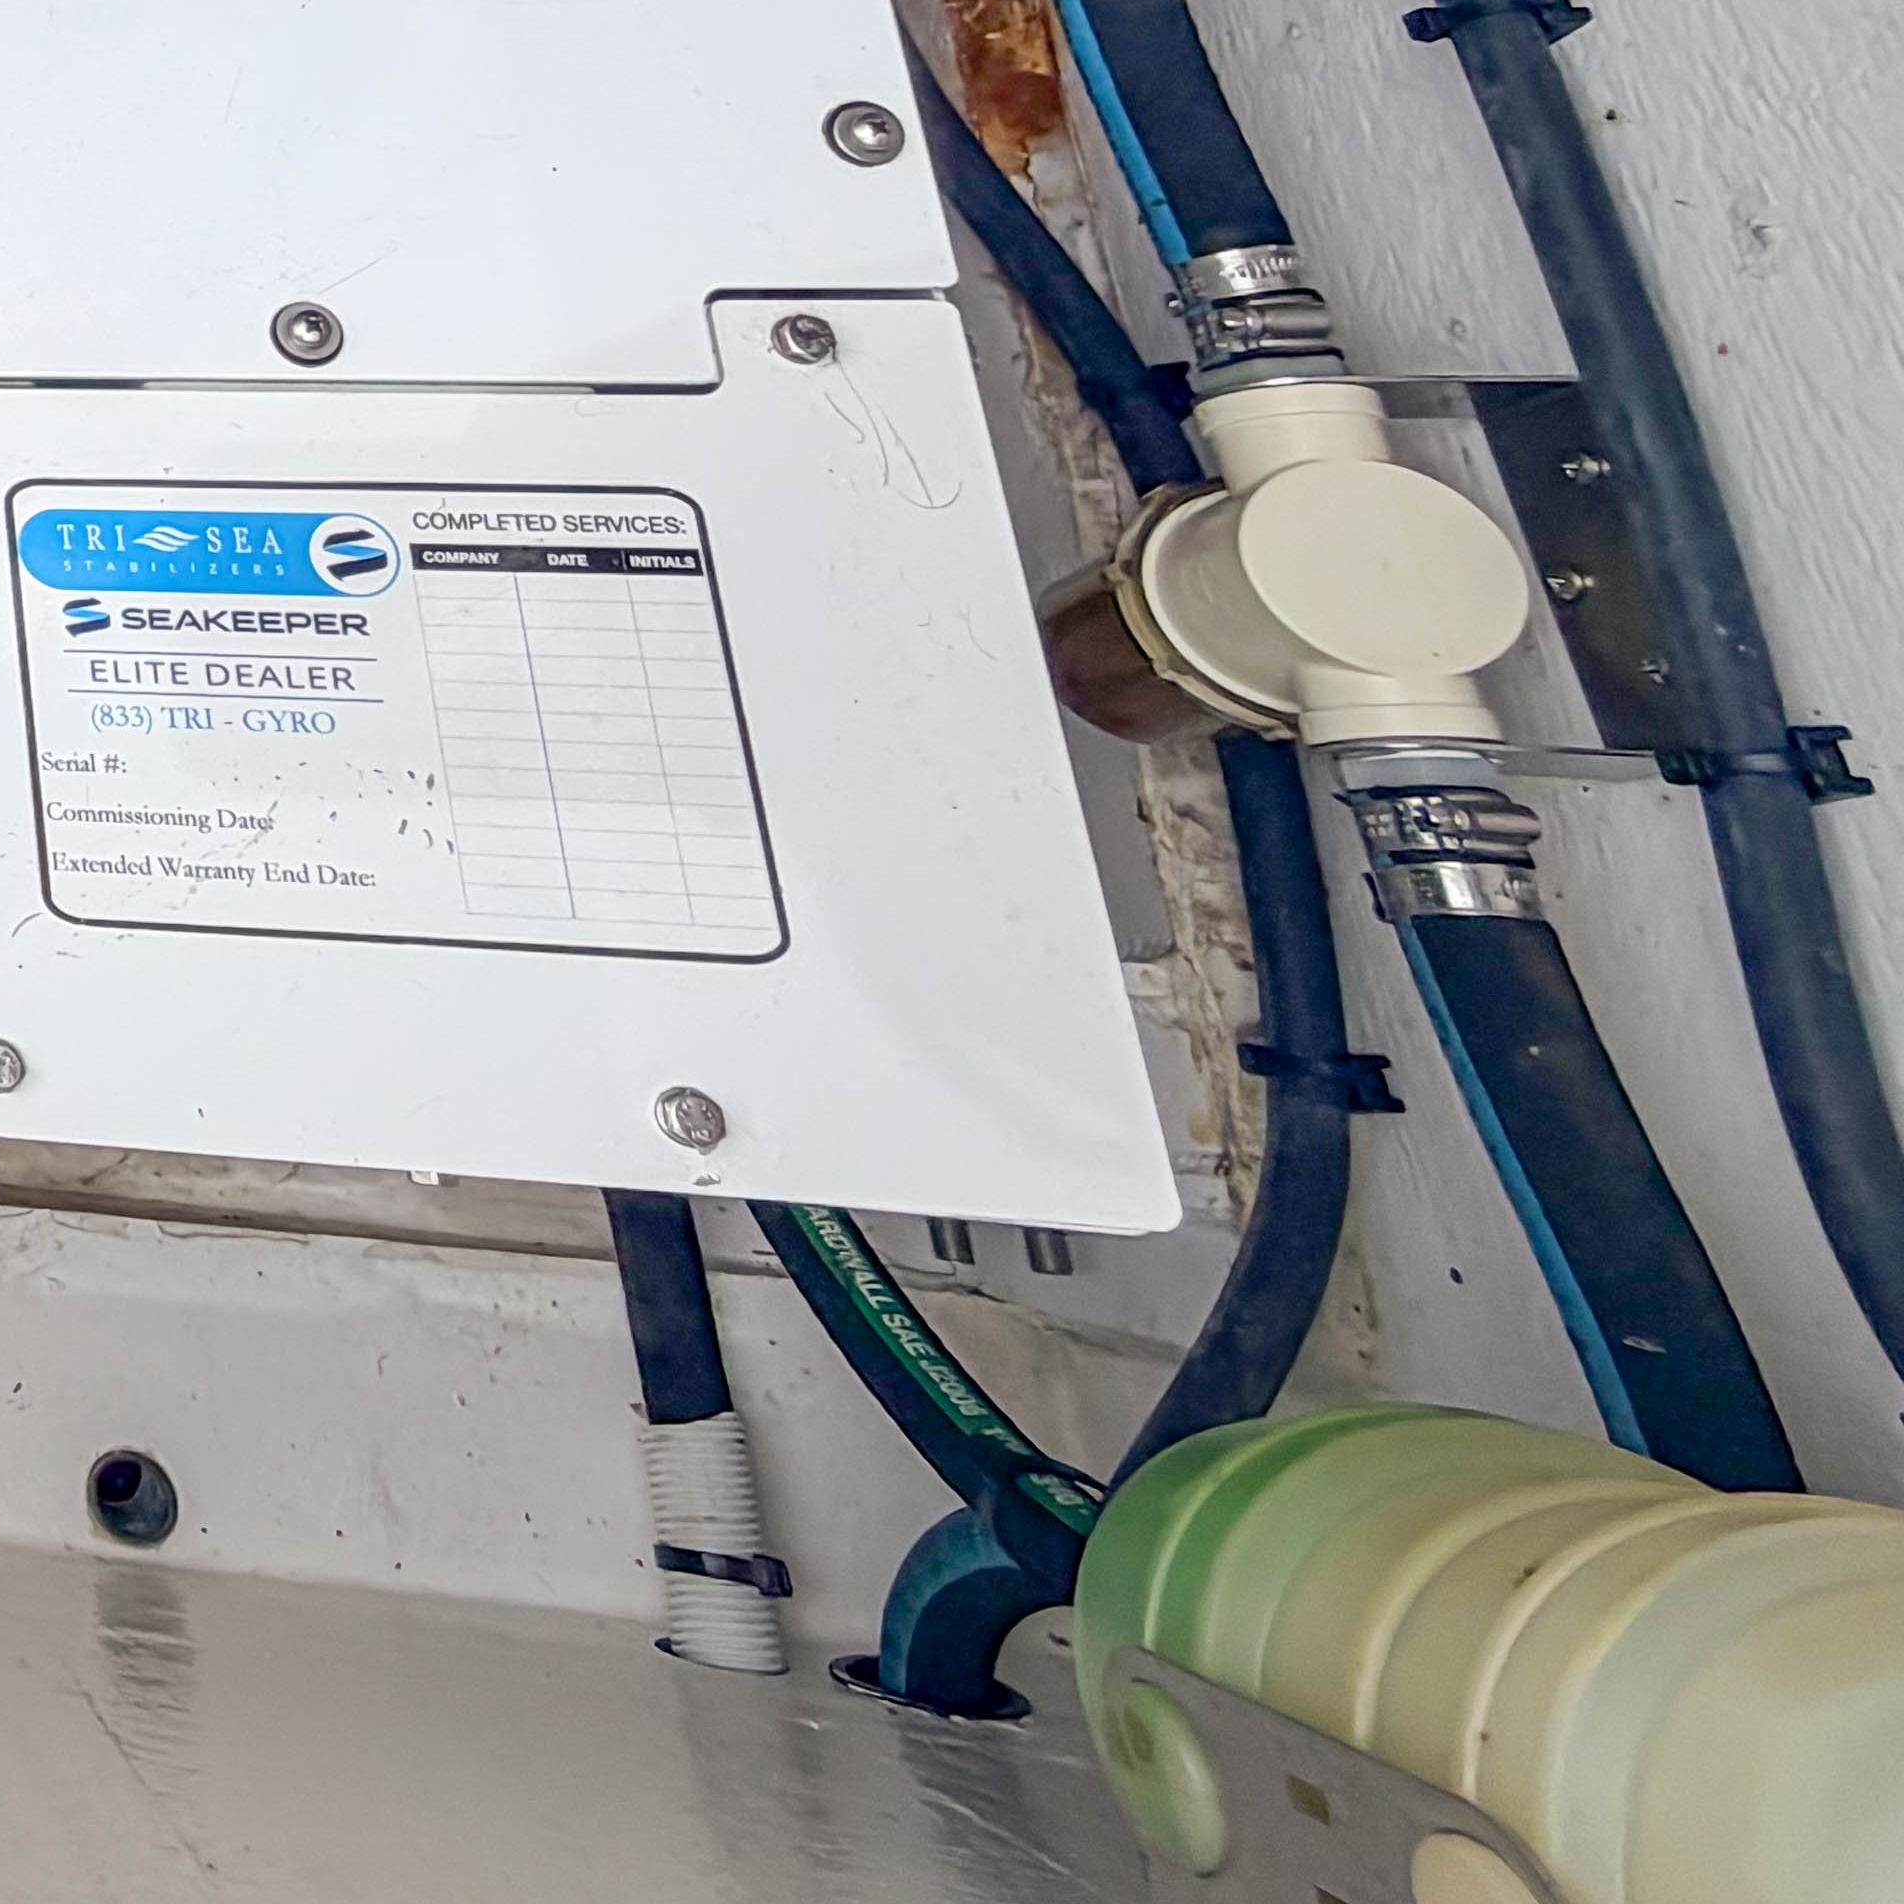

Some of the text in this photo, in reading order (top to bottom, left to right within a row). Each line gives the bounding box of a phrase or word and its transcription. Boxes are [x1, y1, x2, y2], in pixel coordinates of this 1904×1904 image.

[412, 512, 686, 534] COMPLETED SERVICES:
[57, 524, 282, 555] TRI SEA
[63, 559, 284, 576] STABILIZERS
[422, 550, 500, 564] COMPANY
[547, 554, 588, 566] DATE
[629, 556, 696, 568] INITIALS
[121, 607, 370, 636] SEAKEEPER
[90, 659, 355, 691] ELITE DEALER
[91, 704, 152, 734] (833)
[160, 707, 212, 730] TRI
[242, 710, 336, 734] GYRO
[41, 752, 127, 774] Serial #:
[46, 802, 274, 834] Commissioning Date:
[52, 852, 376, 887] Extended Warranty End Date:
[803, 1206, 895, 1310] ARDWALL
[882, 1313, 930, 1357] SAE
